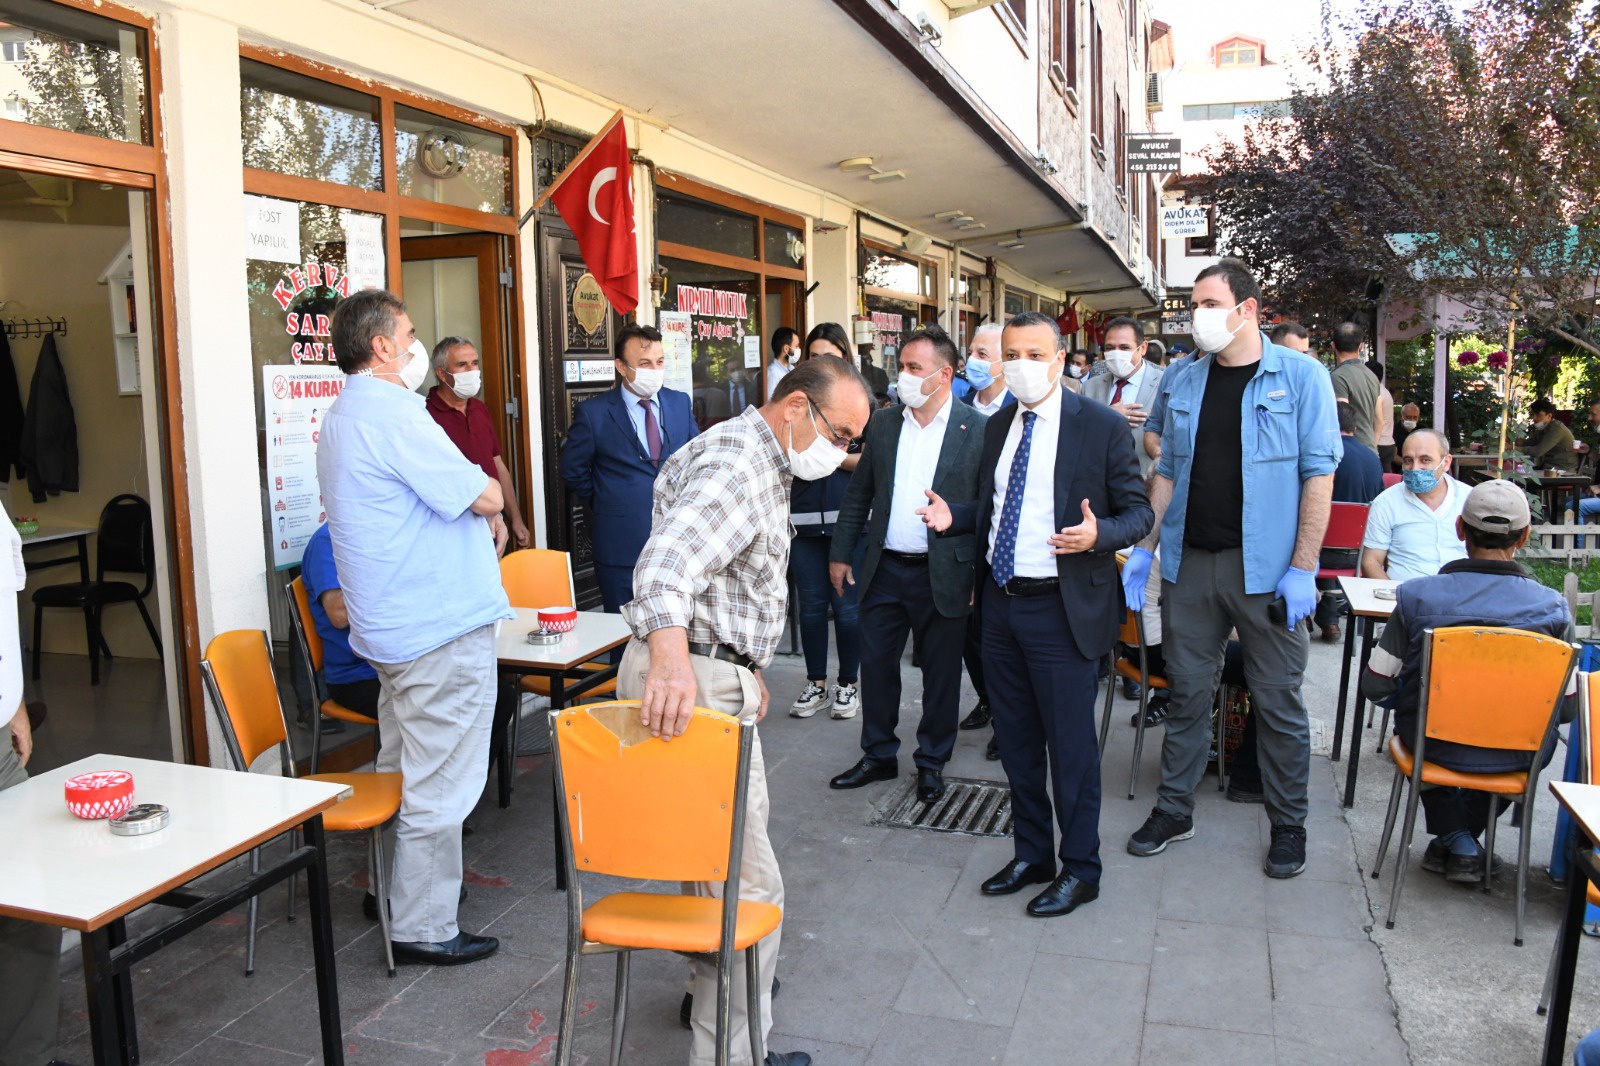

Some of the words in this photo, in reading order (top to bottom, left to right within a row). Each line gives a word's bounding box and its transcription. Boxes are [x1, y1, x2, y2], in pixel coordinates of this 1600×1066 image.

[1164, 208, 1204, 219] AVUKAT
[579, 291, 599, 301] Avukat
[677, 284, 714, 317] KIRMIZI
[714, 289, 748, 319] KOLTUK
[697, 320, 712, 341] Çay
[712, 321, 733, 341] Ağacı
[291, 342, 325, 365] ÇAY
[289, 380, 303, 399] 14
